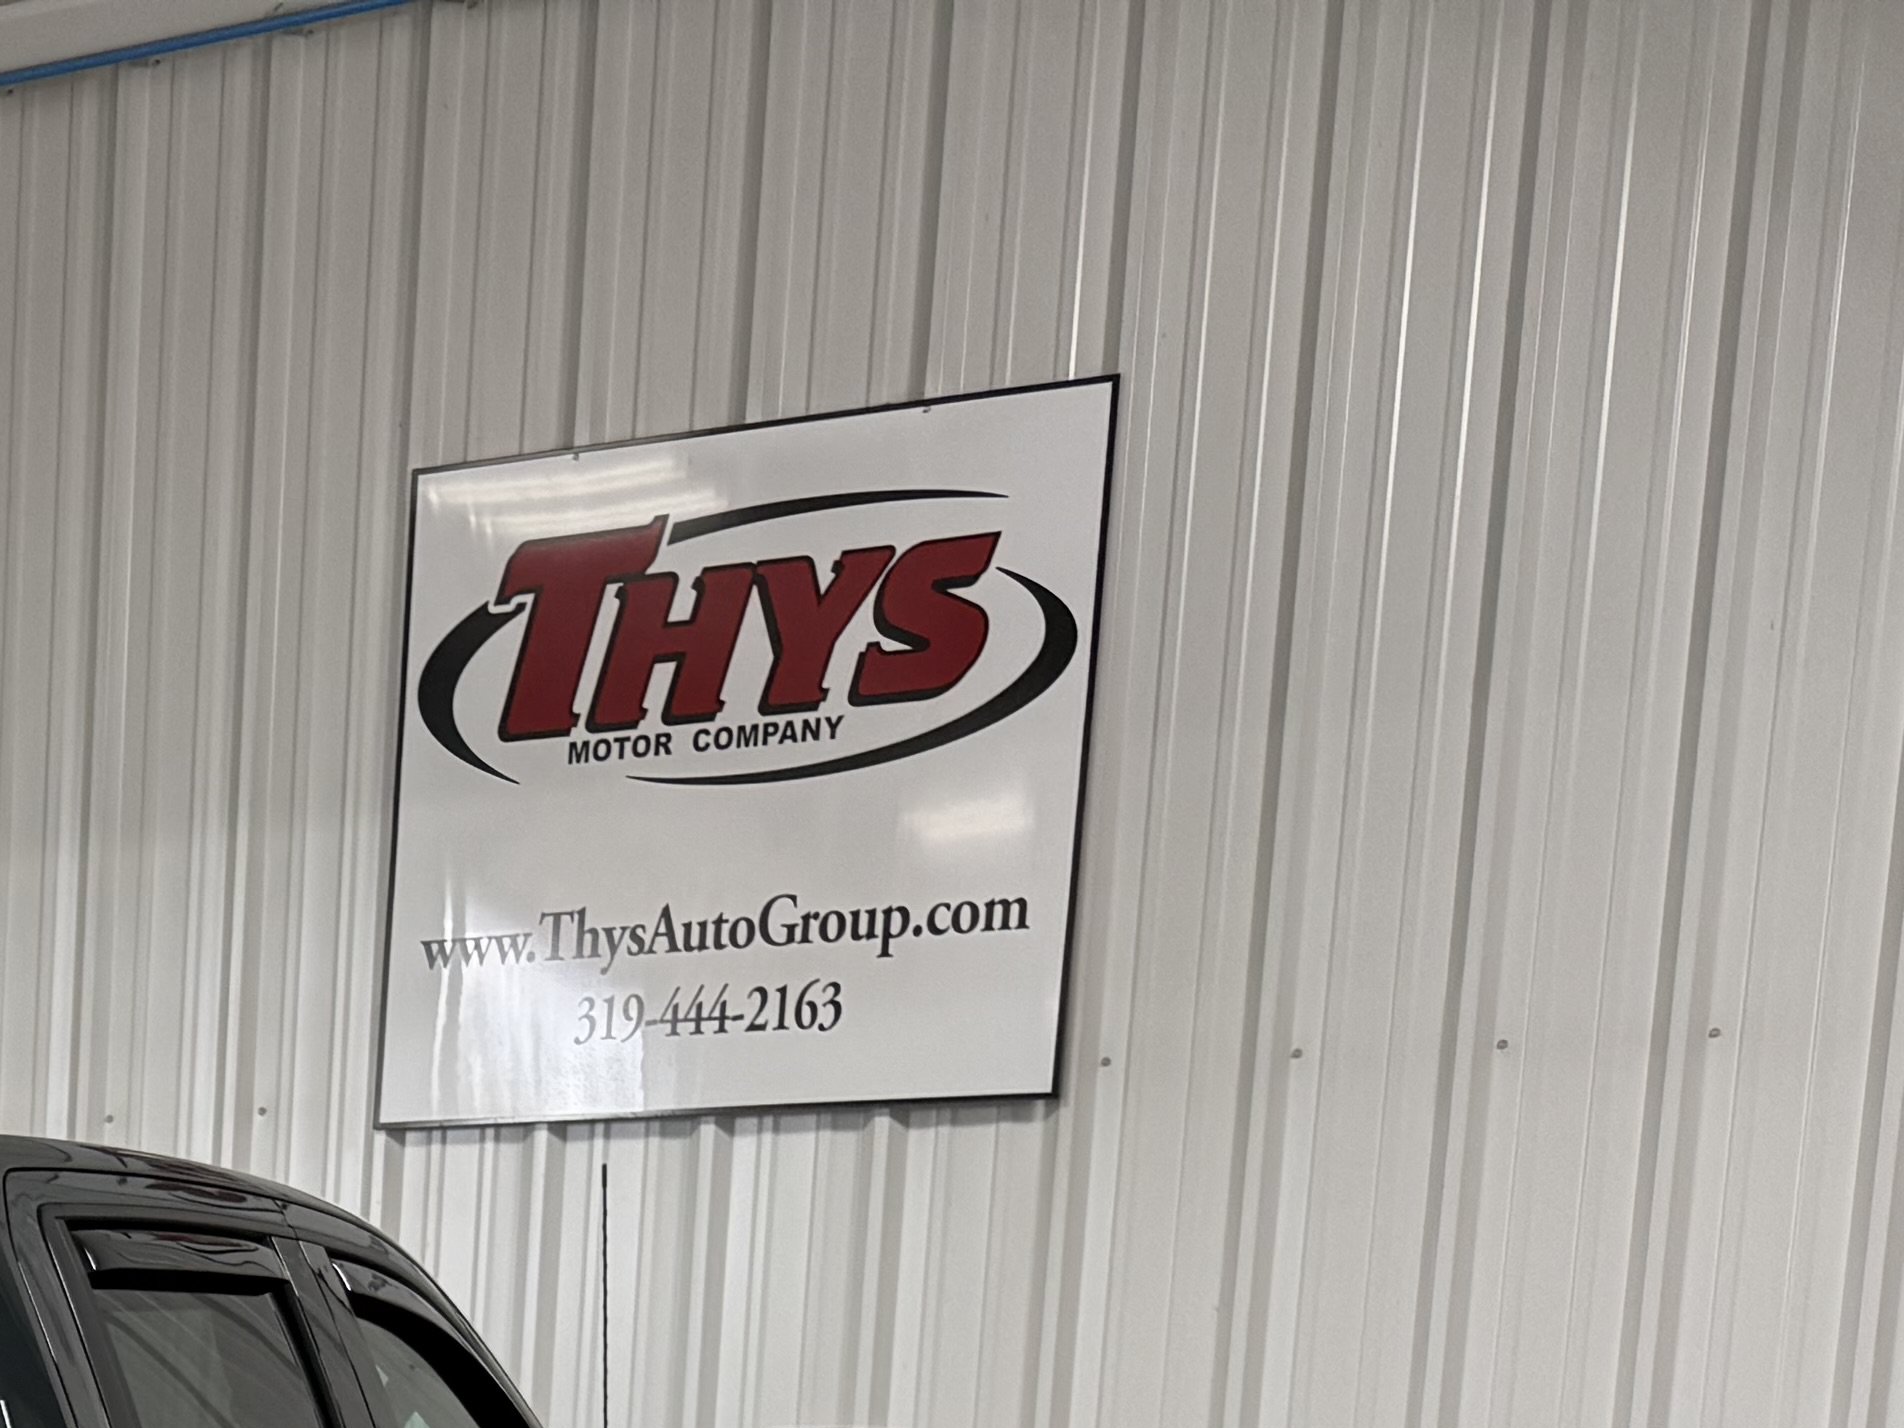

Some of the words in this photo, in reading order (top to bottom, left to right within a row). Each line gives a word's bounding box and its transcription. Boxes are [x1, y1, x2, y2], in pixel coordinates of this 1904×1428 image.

[494, 514, 1002, 743] THYS
[567, 732, 673, 766] MOTOR
[692, 715, 845, 754] COMPANY
[420, 893, 1030, 976] www.ThysAutoGroup.com
[574, 979, 844, 1046] 319-444-2163
